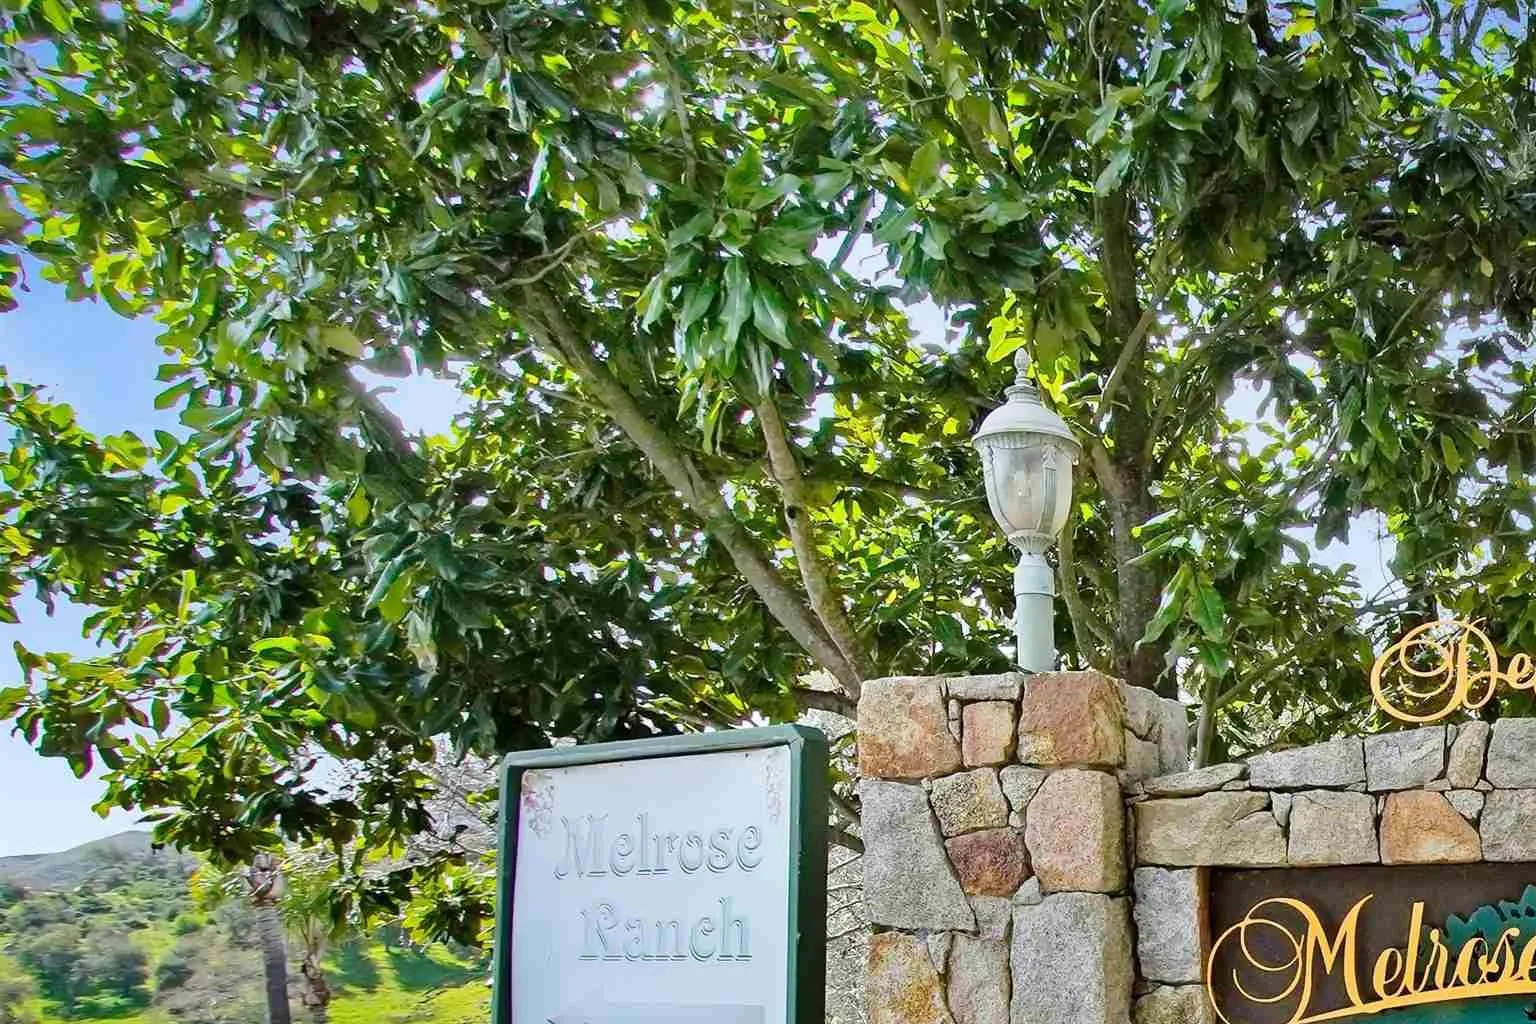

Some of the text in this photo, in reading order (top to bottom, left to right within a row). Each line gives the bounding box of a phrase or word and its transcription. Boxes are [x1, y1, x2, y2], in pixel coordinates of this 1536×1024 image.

[1370, 616, 1536, 723] De
[553, 811, 764, 880] Melrose
[577, 896, 753, 962] Ranch
